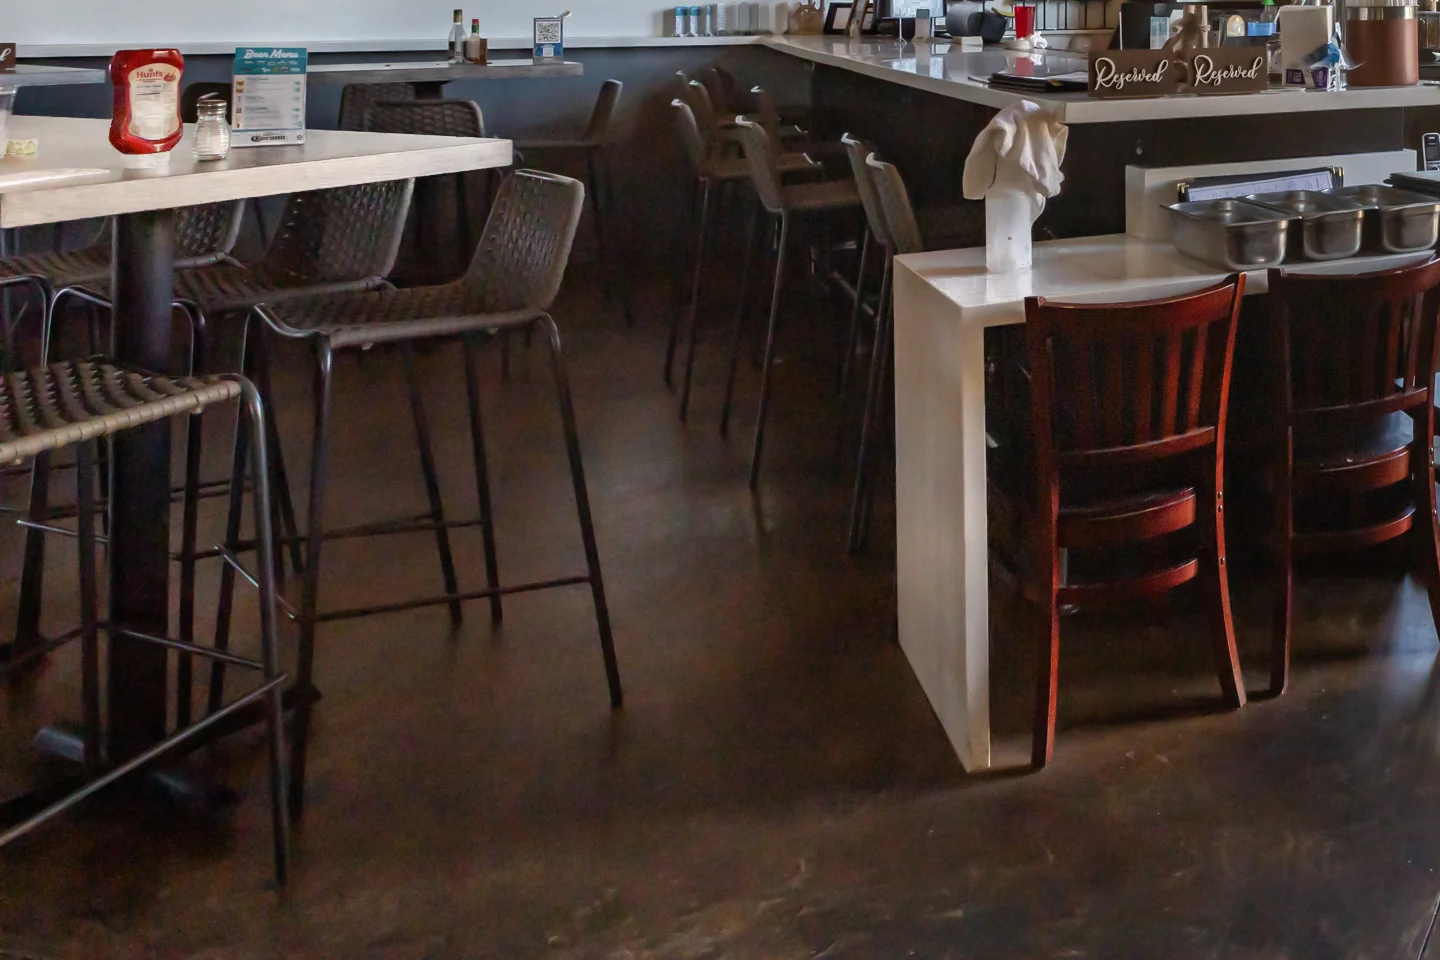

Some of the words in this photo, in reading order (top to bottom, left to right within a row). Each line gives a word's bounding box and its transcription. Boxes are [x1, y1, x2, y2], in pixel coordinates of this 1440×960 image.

[270, 48, 300, 59] Menu
[1094, 57, 1169, 91] Reserved
[1193, 54, 1264, 87] Reserved
